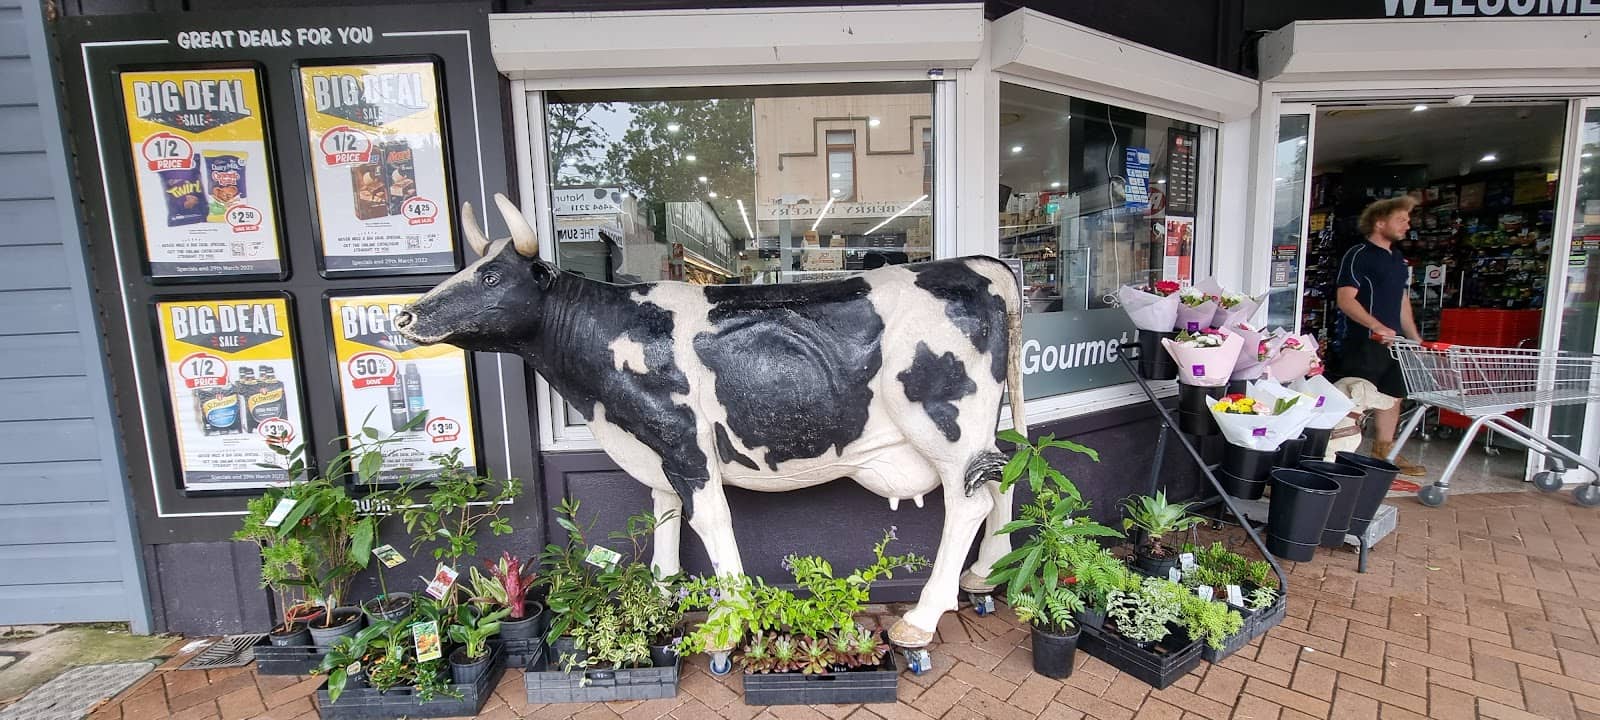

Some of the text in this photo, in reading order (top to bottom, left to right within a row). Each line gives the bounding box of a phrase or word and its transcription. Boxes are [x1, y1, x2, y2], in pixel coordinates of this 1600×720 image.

[177, 26, 373, 49] GREAT DEALS FOR YOU
[133, 79, 251, 118] BIG DEAL
[312, 72, 428, 112] BIG DEAL
[183, 113, 205, 126] SALE
[362, 107, 383, 120] SALE
[154, 139, 179, 158] 1/2
[333, 133, 358, 152] 1/2
[157, 158, 183, 169] PRICE
[335, 152, 361, 163] PRICE
[171, 303, 283, 339] BIG DEAL
[341, 306, 384, 339] BIG
[218, 335, 240, 348] SALE
[1023, 331, 1128, 375] Gourmet
[191, 360, 214, 376] 1/2
[356, 359, 377, 376] 50
[193, 378, 219, 387] PRICE
